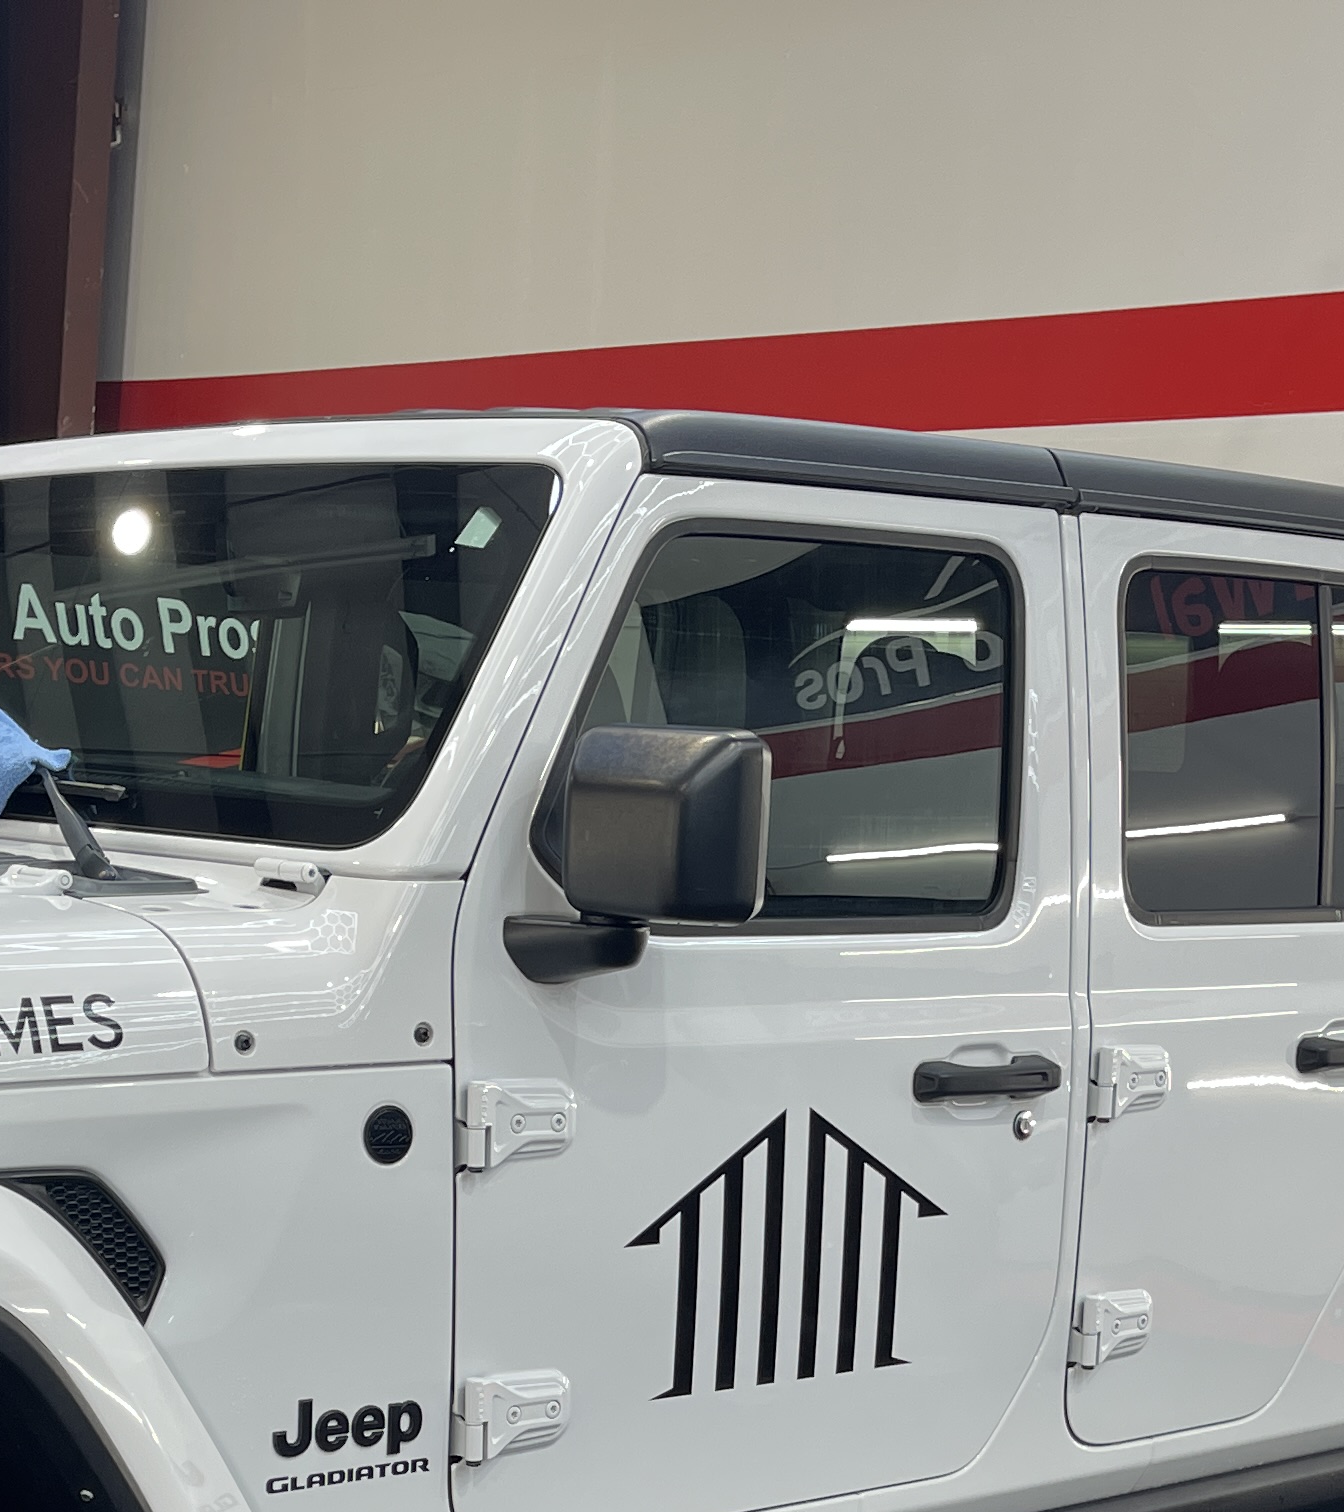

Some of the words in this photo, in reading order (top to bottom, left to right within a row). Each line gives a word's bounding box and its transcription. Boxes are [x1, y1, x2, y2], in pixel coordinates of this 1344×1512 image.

[13, 583, 145, 651] Auto
[44, 656, 110, 686] YOU
[120, 663, 183, 692] CAN
[272, 1398, 423, 1458] Jeep
[265, 1457, 430, 1494] GLADIATOR
